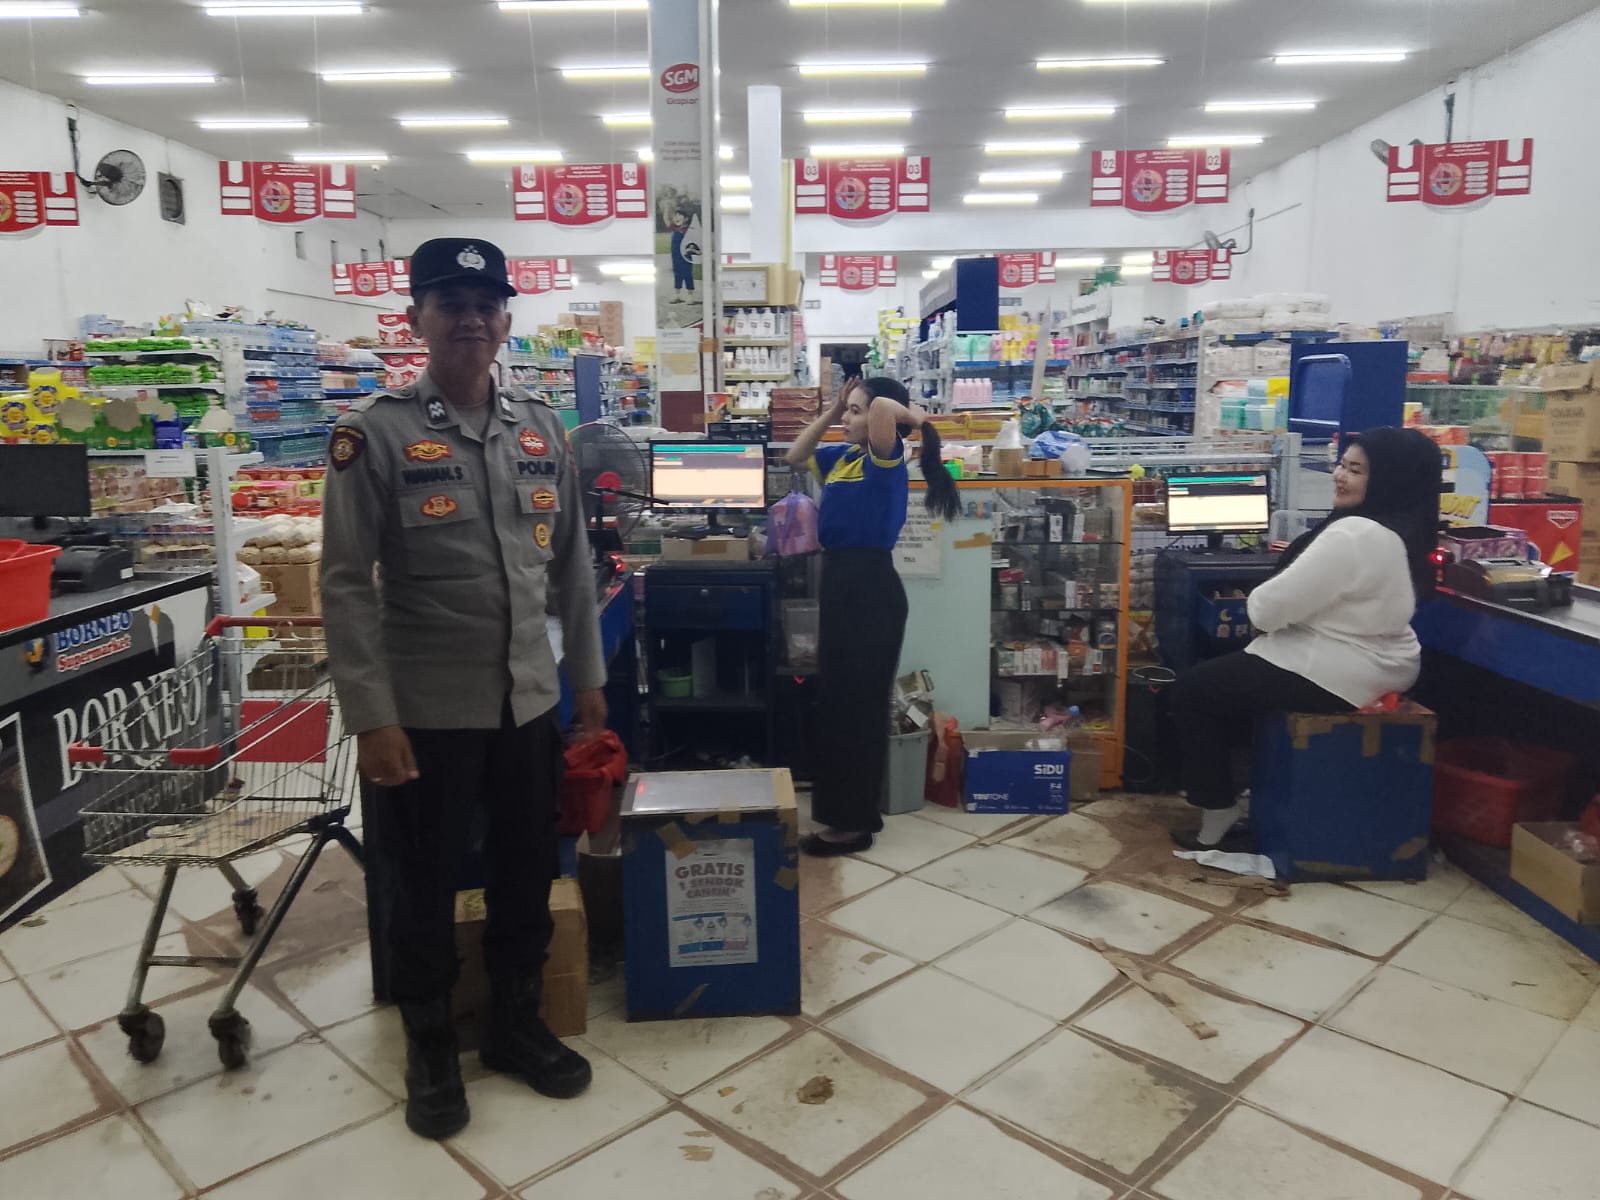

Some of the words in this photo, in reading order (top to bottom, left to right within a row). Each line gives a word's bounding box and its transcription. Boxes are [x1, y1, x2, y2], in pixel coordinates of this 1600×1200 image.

[664, 68, 698, 87] SGM
[1102, 159, 1115, 169] 02
[1207, 155, 1220, 166] 02
[805, 165, 818, 175] 03
[908, 164, 920, 174] 03
[522, 173, 535, 183] 04
[623, 171, 636, 181] 04
[53, 609, 133, 652] BORNEO
[57, 633, 132, 672] Supermarket
[54, 666, 210, 790] BORNEO
[1033, 764, 1064, 775] SiDU
[674, 862, 745, 879] GRATIS
